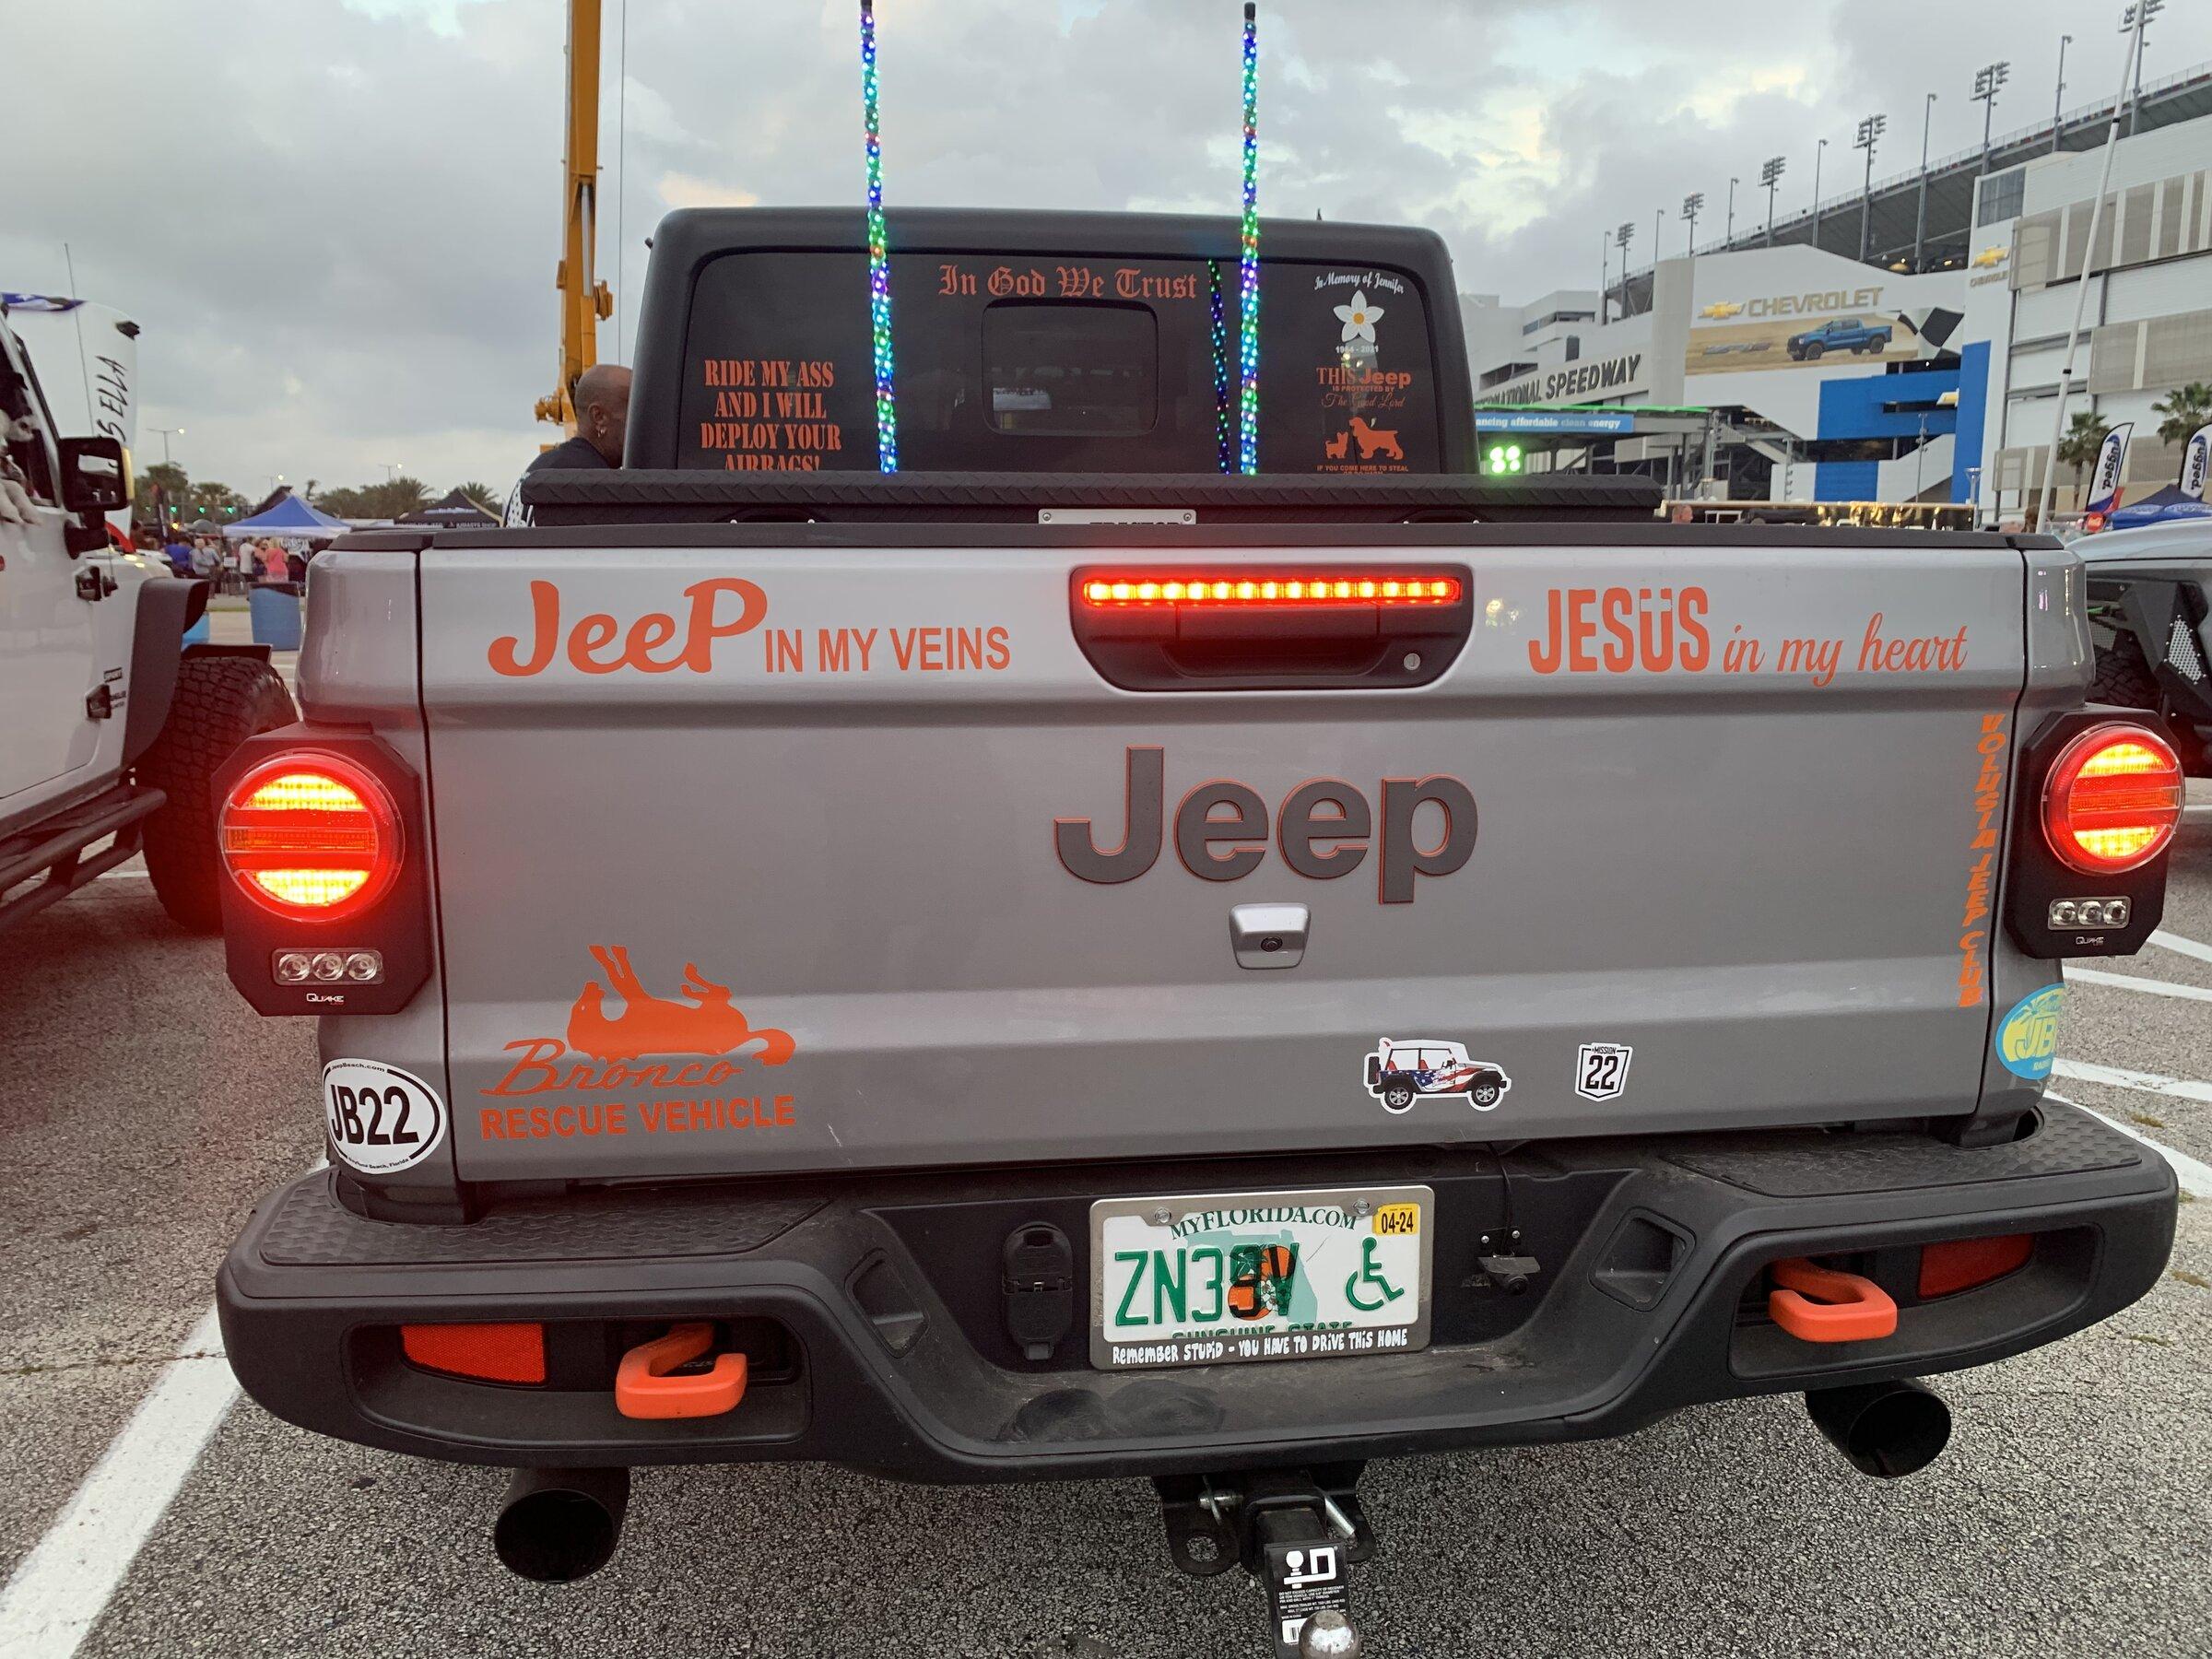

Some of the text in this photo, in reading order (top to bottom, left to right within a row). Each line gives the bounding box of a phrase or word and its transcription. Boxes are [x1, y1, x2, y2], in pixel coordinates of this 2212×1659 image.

[938, 265, 1197, 300] In God We Trust
[1314, 271, 1405, 295] In Memory of Jennifer
[1747, 287, 1884, 318] CHEVROLET
[96, 356, 128, 418] ELLA
[704, 359, 835, 388] RIDE MY ASS
[1316, 367, 1412, 389] THIS Jeep
[1546, 354, 1641, 399] SPEEDWAY
[714, 391, 828, 419] AND I WILL
[700, 422, 842, 451] DEPLOY YOUR
[1511, 417, 1559, 428] affordable
[1560, 418, 1586, 428] clean
[1588, 418, 1621, 429] energy
[764, 629, 804, 673] IN
[818, 628, 878, 672] MY
[888, 626, 1011, 671] VEINS
[1723, 624, 1765, 674] in
[1776, 638, 1844, 688] my
[1857, 611, 1968, 674] heart
[1053, 745, 1478, 905] Jeep
[1958, 713, 2006, 1007] VOLUSIA JEEP CLUB
[1594, 1046, 1617, 1054] MISSION
[479, 1038, 745, 1097] Bronco
[1584, 1054, 1618, 1089] 22
[330, 1084, 420, 1146] JB22
[479, 1095, 797, 1141] RESCUE VEHICLE
[1170, 1206, 1358, 1240] MYFLORIDA.COM
[1382, 1212, 1414, 1233] 04-24
[1238, 1339, 1259, 1358] YOU
[1264, 1335, 1290, 1356] HAVE
[1293, 1335, 1308, 1354] TO
[1377, 1328, 1408, 1348] HOME
